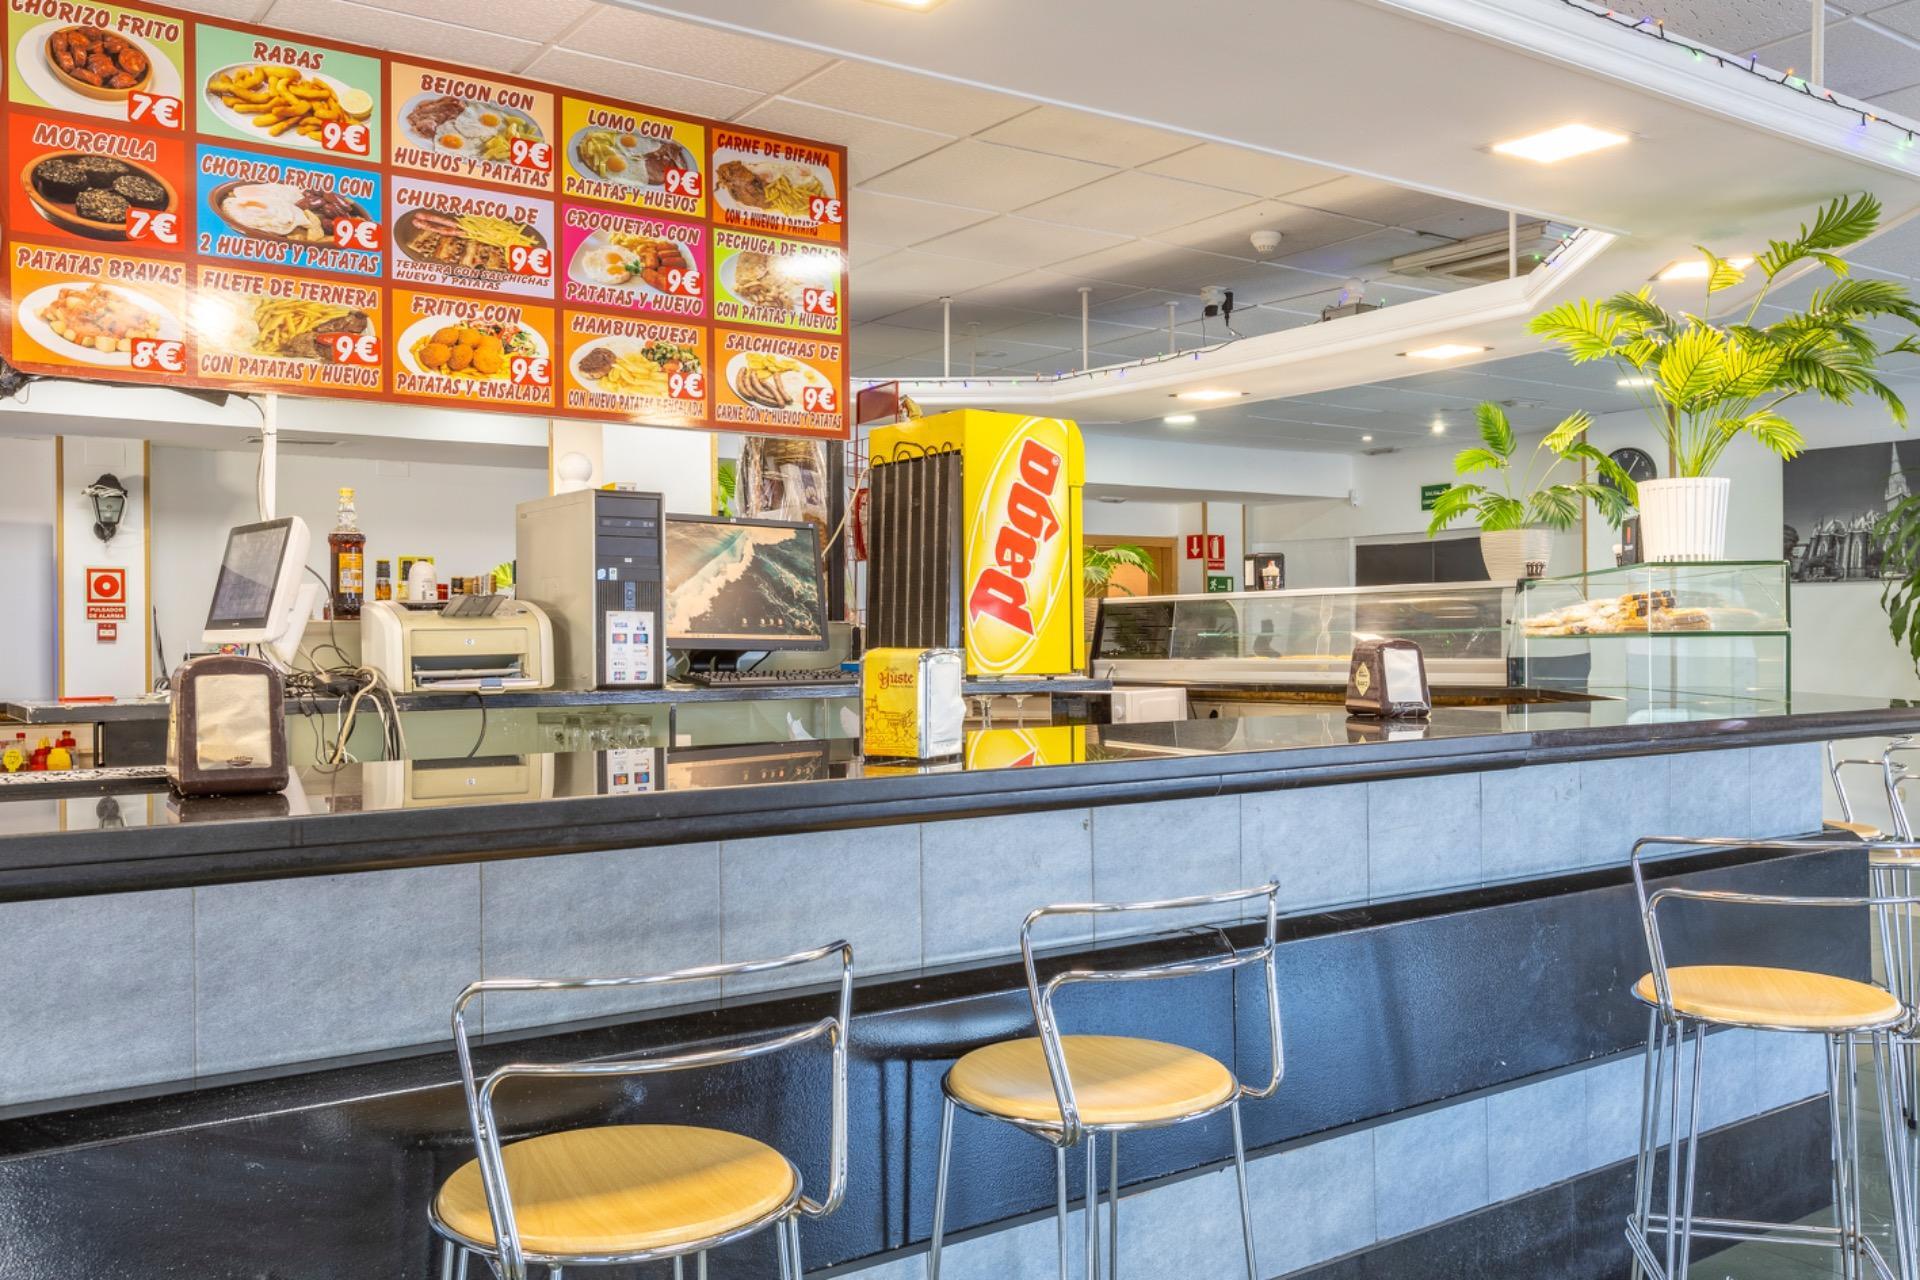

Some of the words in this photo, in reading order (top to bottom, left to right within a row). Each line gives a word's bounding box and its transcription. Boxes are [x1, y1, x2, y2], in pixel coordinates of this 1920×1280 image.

[12, 0, 110, 29] CHORIZO
[117, 13, 180, 42] FRITO
[253, 42, 324, 69] RABAS
[421, 74, 491, 103] BEICON
[497, 90, 534, 111] CON
[131, 94, 178, 128] 7€
[588, 109, 635, 132] LOMO
[641, 121, 674, 139] CON
[33, 123, 156, 161] MORCILLA
[324, 123, 367, 151] 9€
[717, 133, 760, 154] CARNE
[764, 142, 781, 158] DE
[785, 146, 830, 167] BIFANA
[394, 147, 462, 172] HUEVOS
[468, 159, 477, 175] Y
[482, 161, 550, 188] PATATAS
[512, 140, 549, 169] 9€
[201, 154, 280, 184] CHORIZO
[285, 168, 334, 192] FRITO
[339, 177, 374, 198] CON
[666, 169, 700, 195] 9€
[396, 188, 508, 220] CHURRASCO
[514, 206, 539, 224] DE
[566, 176, 628, 201] PATATAS
[632, 188, 640, 202] Y
[645, 190, 698, 213] HUEVOS
[725, 208, 740, 224] CON
[743, 211, 748, 225] 2
[751, 212, 779, 230] HUEVOS
[781, 216, 787, 230] Y
[812, 199, 842, 223] 9€
[129, 211, 177, 243] 7€
[336, 220, 378, 249] 9€
[566, 209, 662, 238] CROQUETAS
[668, 226, 700, 245] CON
[200, 234, 211, 252] 2
[217, 234, 288, 262] HUEVOS
[293, 245, 303, 263] Y
[307, 248, 379, 273] PATATAS
[717, 232, 776, 255] PECHUGA
[781, 242, 797, 257] DE
[801, 244, 838, 259] POO
[17, 248, 103, 276] PATATAS
[109, 259, 183, 285] BRAVAS
[396, 259, 452, 275] TERNERA
[454, 266, 480, 277] CON
[482, 270, 550, 286] SALCHICHAS
[512, 247, 549, 275] 9€
[203, 270, 263, 294] FILETE
[270, 278, 294, 298] DE
[299, 282, 378, 308] TERNERA
[397, 271, 437, 282] HUEVO
[441, 274, 449, 283] Y
[452, 277, 500, 291] PATATAS
[668, 269, 700, 294] 9€
[412, 296, 478, 318] FRITOS
[484, 305, 521, 323] CON
[566, 282, 634, 306] PATATAS
[640, 292, 648, 307] Y
[652, 294, 703, 316] HUEVO
[805, 290, 836, 314] 9€
[572, 315, 698, 344] HAMBURGUESA
[716, 302, 738, 318] CON
[742, 305, 787, 325] PATATAS
[790, 311, 796, 325] Y
[799, 312, 838, 330] HUEVOS
[133, 341, 183, 371] 8€
[336, 336, 378, 363] 9€
[725, 334, 815, 357] SALCHICHAS
[820, 345, 839, 360] DE
[201, 354, 233, 373] CON
[239, 358, 304, 380] PATATAS
[309, 364, 318, 381] Y
[322, 365, 379, 386] HUEVOS
[512, 358, 549, 384] 9€
[397, 374, 461, 394] PATATAS
[466, 379, 475, 396] Y
[479, 381, 550, 402] ENSALADA
[670, 373, 703, 398] 9€
[805, 388, 835, 411] 9€
[568, 391, 585, 406] CON
[588, 393, 616, 409] HUEVO
[716, 404, 743, 420] CARNE
[745, 407, 761, 421] CON
[764, 409, 769, 422] 2
[772, 408, 801, 425] HUEVOS
[803, 411, 808, 426] Y
[811, 411, 842, 428] PATATAS
